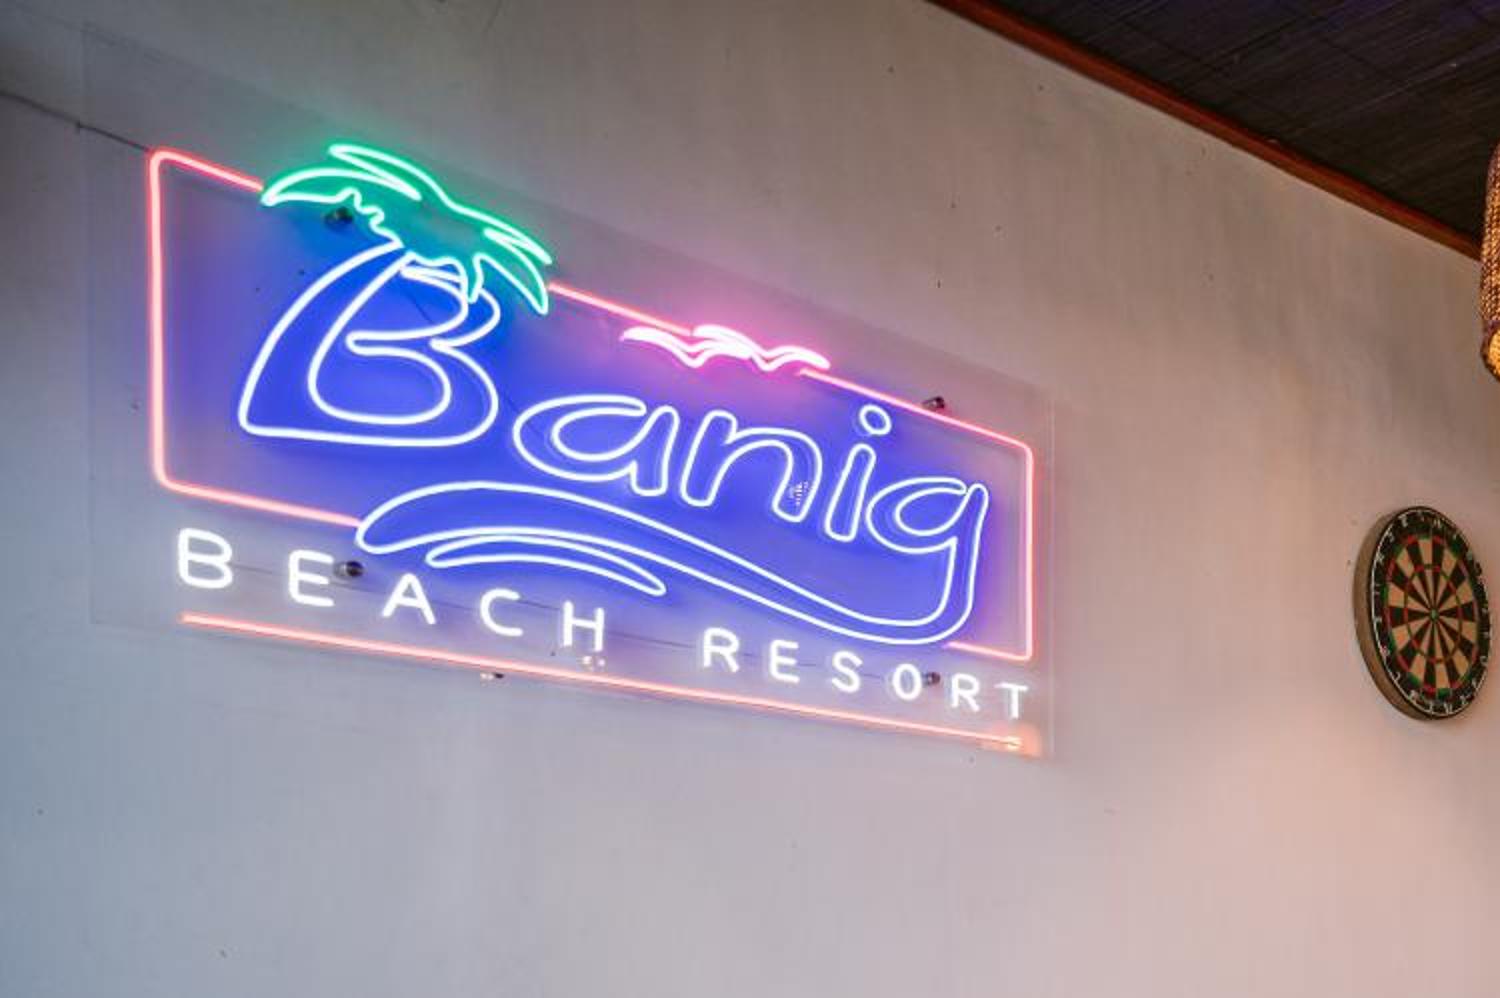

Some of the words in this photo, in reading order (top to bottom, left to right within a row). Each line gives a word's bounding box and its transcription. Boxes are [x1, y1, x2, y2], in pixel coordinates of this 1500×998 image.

[239, 244, 989, 644] Banig
[177, 527, 605, 652] BEACH
[701, 627, 1029, 719] RESORT
